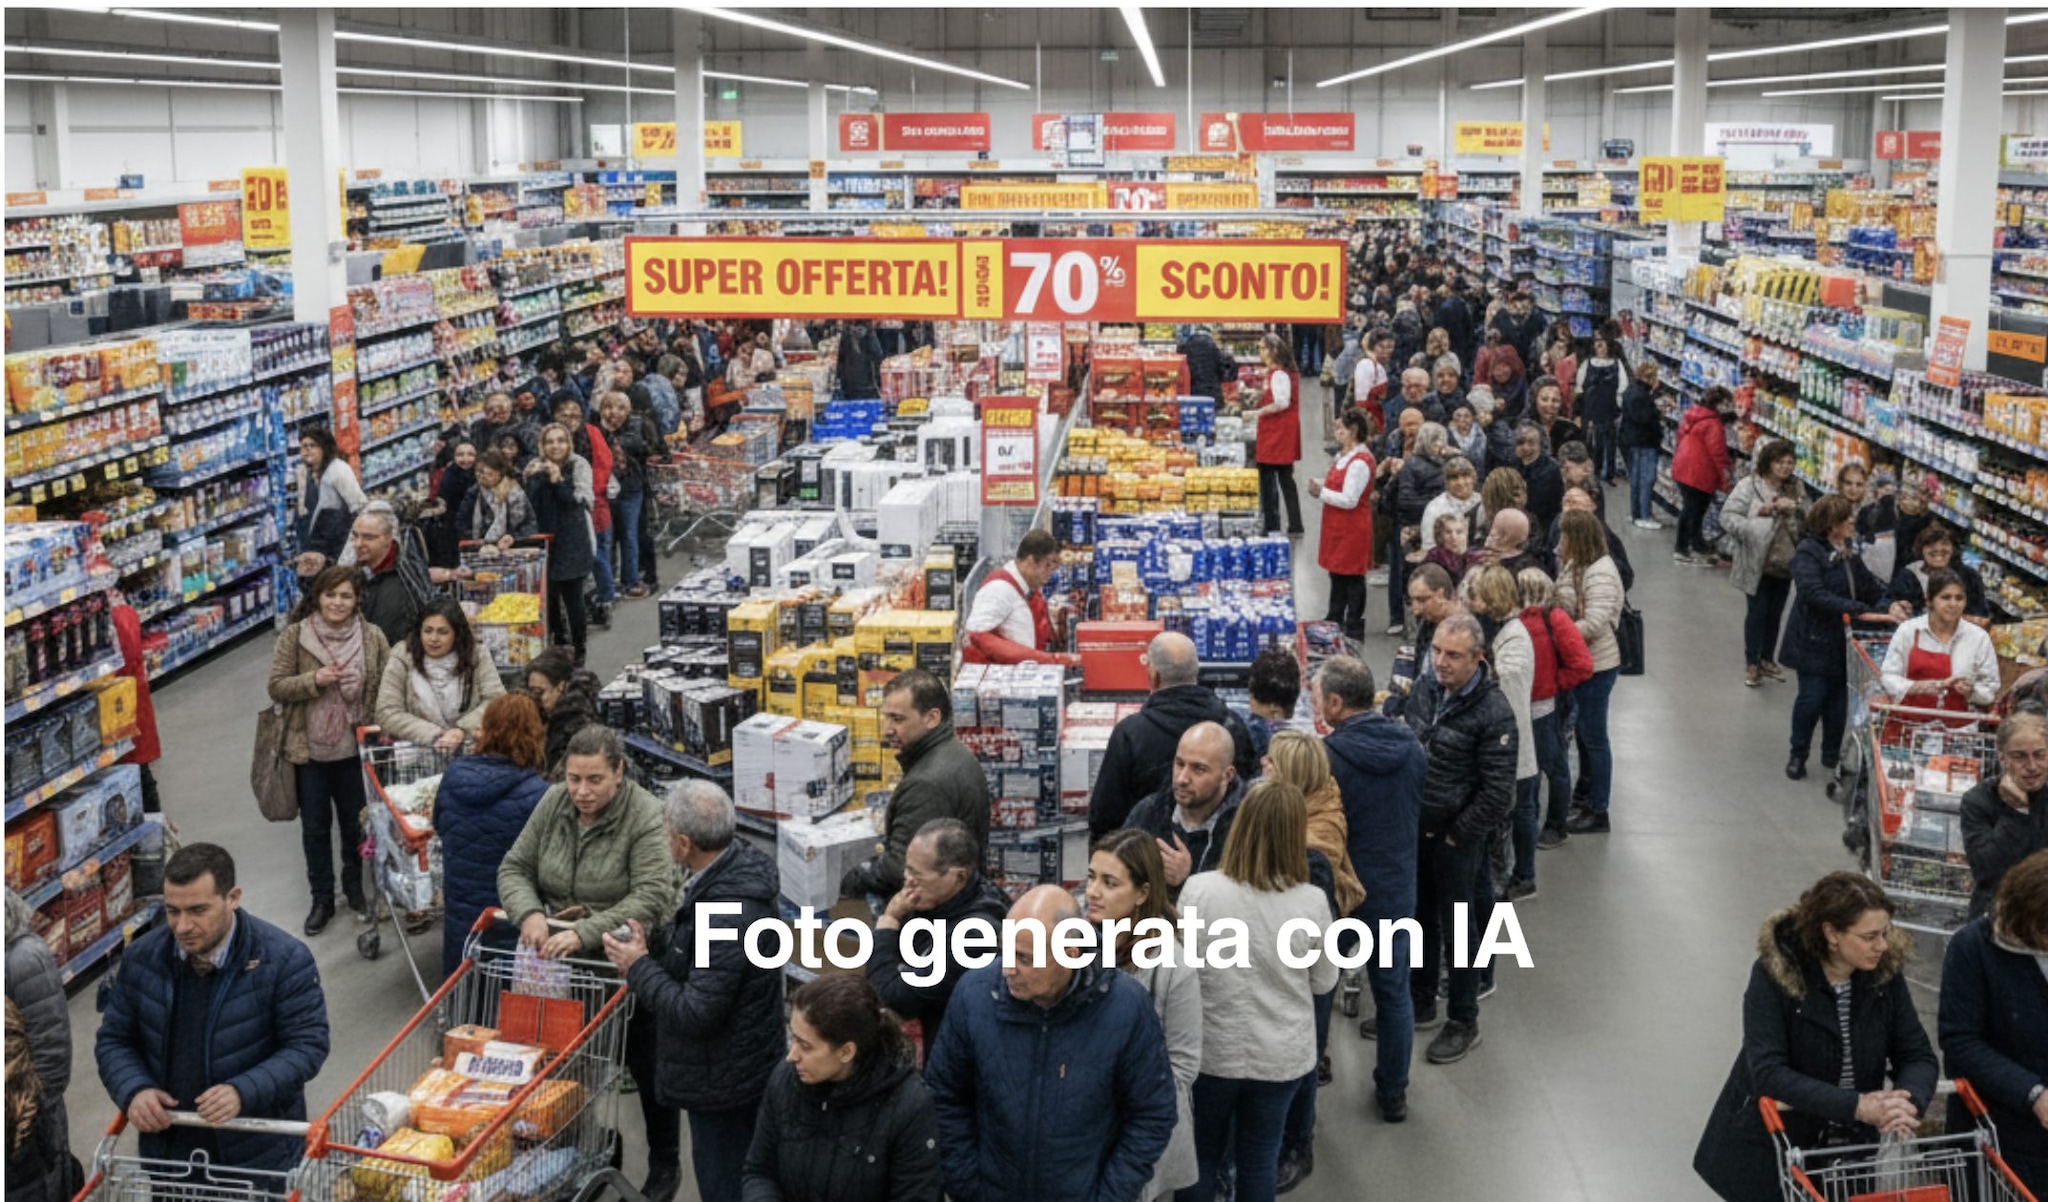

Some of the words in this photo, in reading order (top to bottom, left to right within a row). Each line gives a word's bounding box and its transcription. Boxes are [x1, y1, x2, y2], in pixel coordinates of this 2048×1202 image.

[643, 257, 763, 295] SUPER
[776, 258, 948, 297] OFFERTA!
[1160, 260, 1331, 301] SCONTO!
